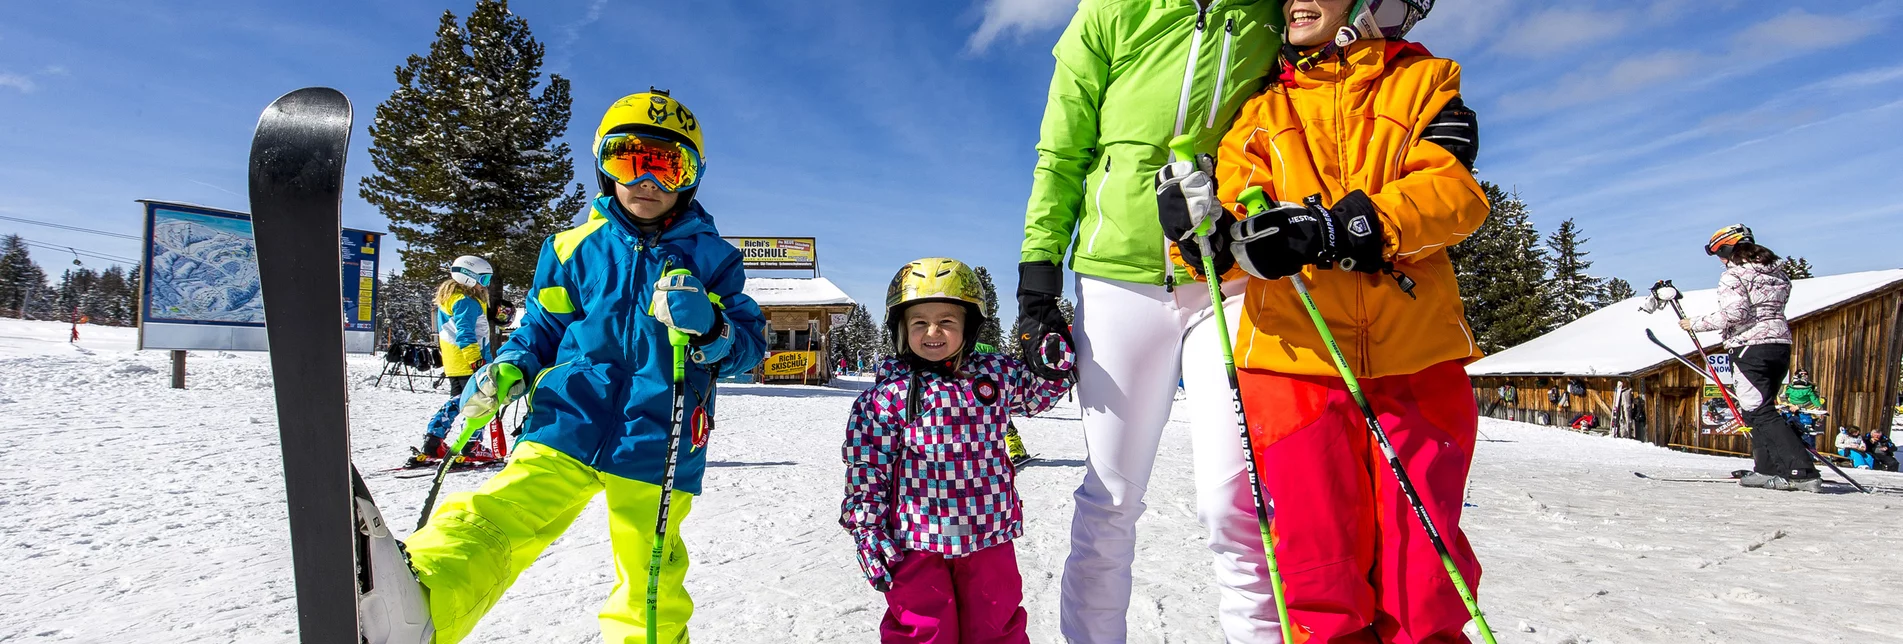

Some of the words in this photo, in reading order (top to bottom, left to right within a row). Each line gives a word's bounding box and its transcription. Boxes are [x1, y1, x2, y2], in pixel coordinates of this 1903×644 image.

[740, 248, 787, 258] KISCHULE
[744, 240, 770, 248] Richi's
[660, 395, 685, 533] KOMPERDELL
[1230, 388, 1260, 508] KOMPERDELL
